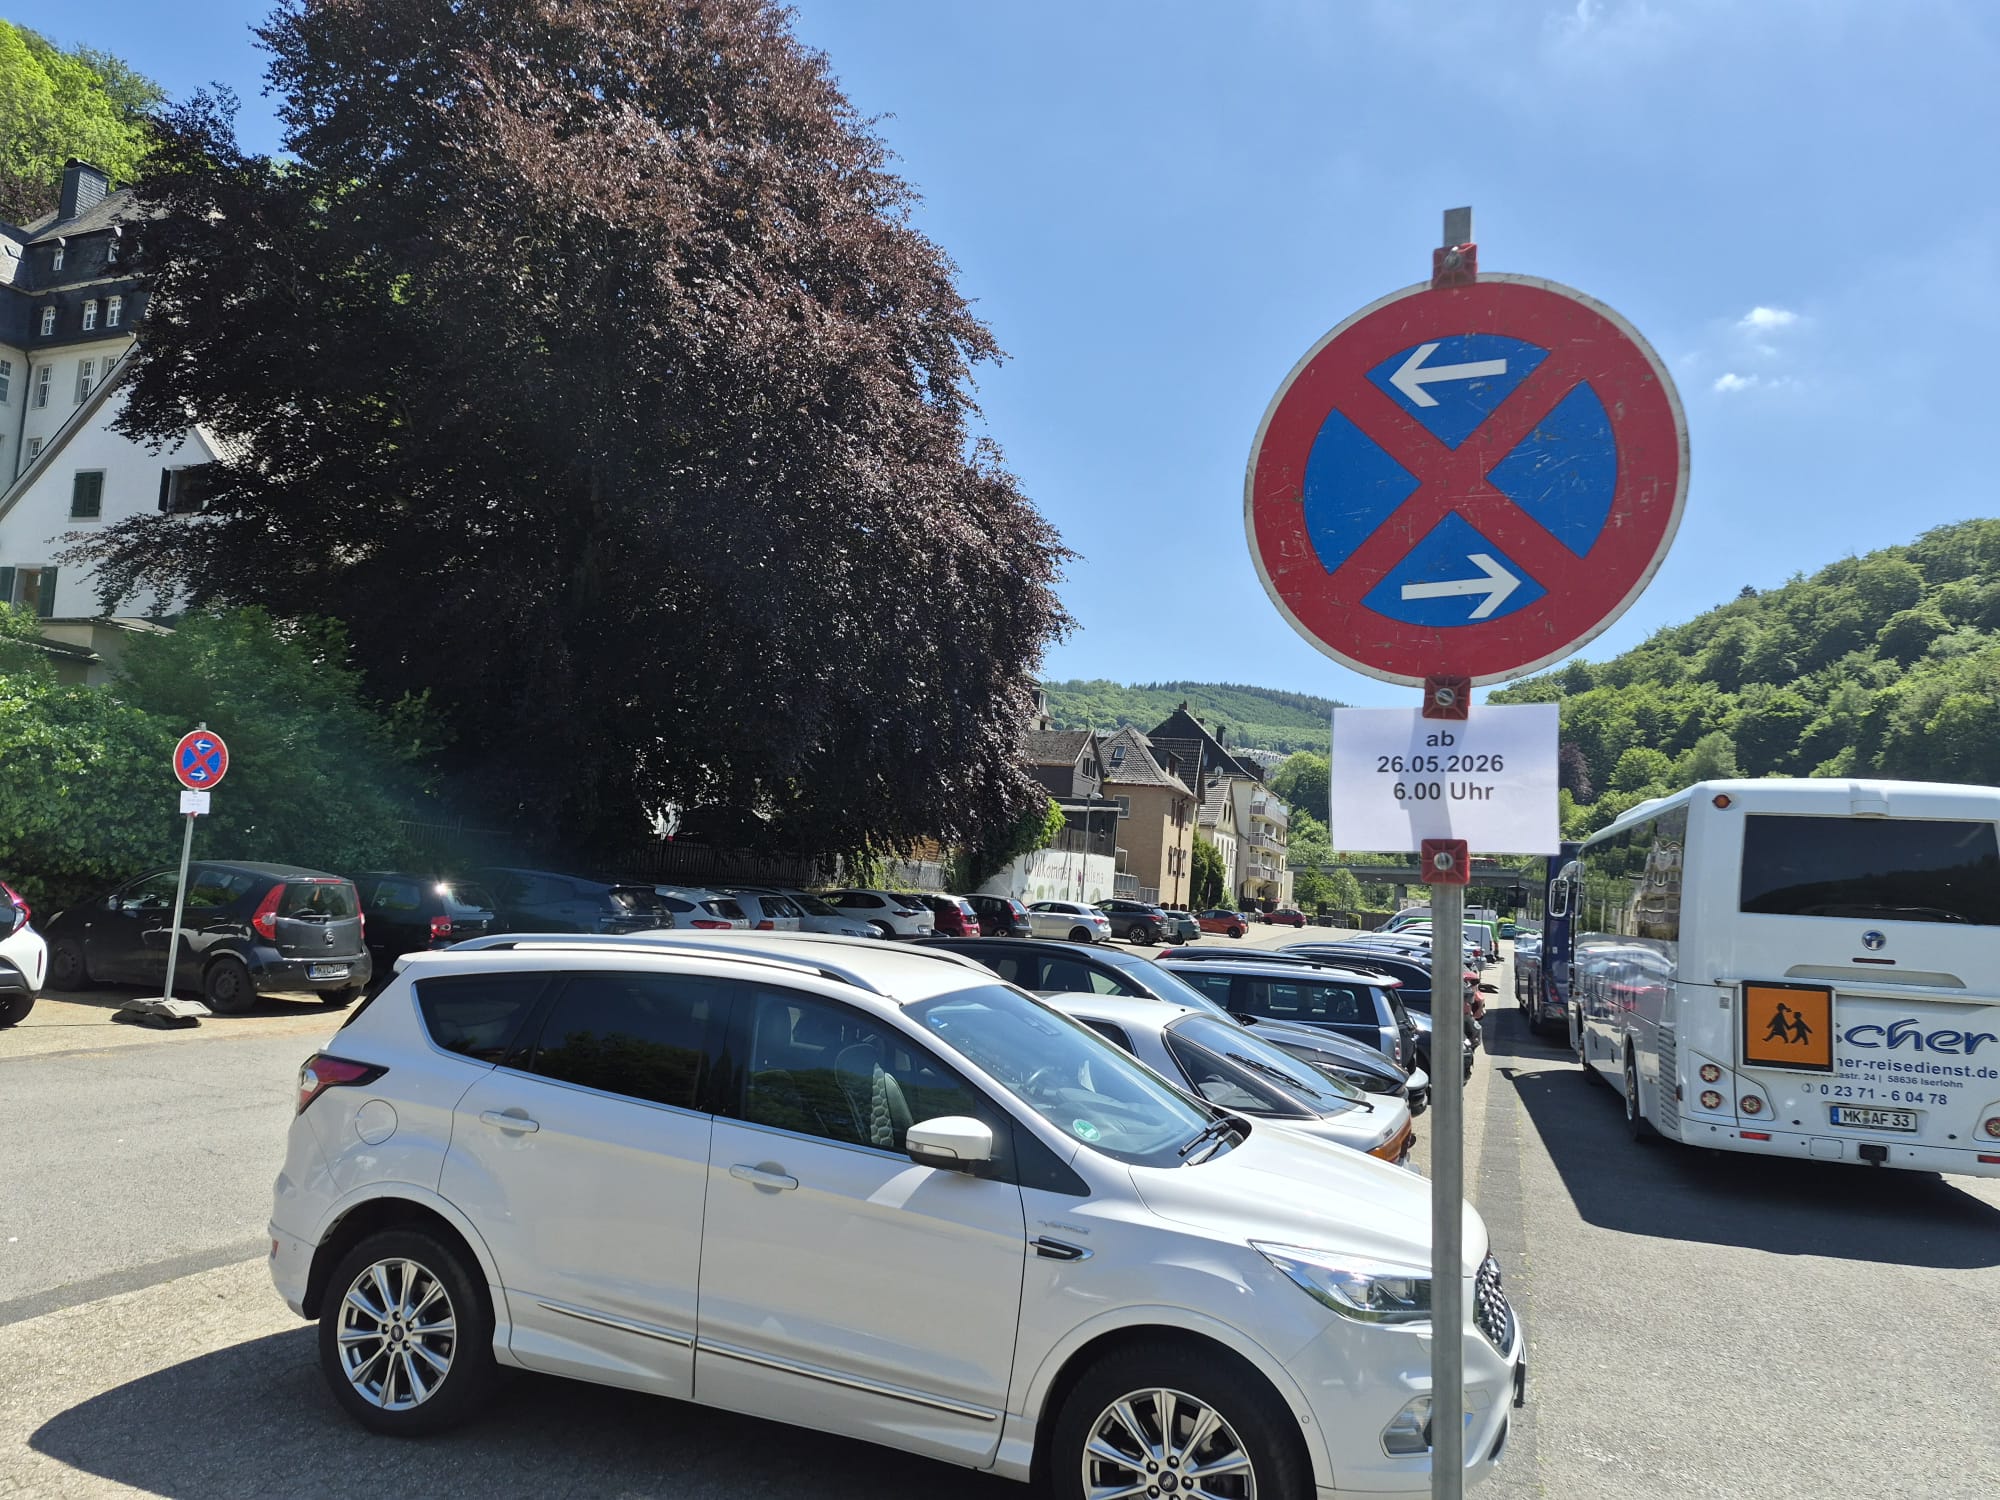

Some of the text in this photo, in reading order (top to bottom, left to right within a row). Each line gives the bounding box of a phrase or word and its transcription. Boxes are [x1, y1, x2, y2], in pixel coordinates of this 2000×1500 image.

[1426, 730, 1455, 747] ab
[1376, 755, 1504, 773] 26.05.2026
[1393, 782, 1495, 801] 6.00 Uhr
[1835, 1018, 1999, 1055] cher
[1863, 1073, 1876, 1081] 24
[1887, 1075, 1918, 1085] 58636
[1920, 1079, 1964, 1089] Iserlohn
[1820, 1084, 1829, 1095] 0
[1834, 1085, 1852, 1097] 23
[1858, 1087, 1875, 1099] 71
[1891, 1090, 1900, 1101] 6
[1905, 1091, 1924, 1103] 04
[1929, 1093, 1948, 1105] 78
[1843, 1109, 1910, 1127] MK AF 33
